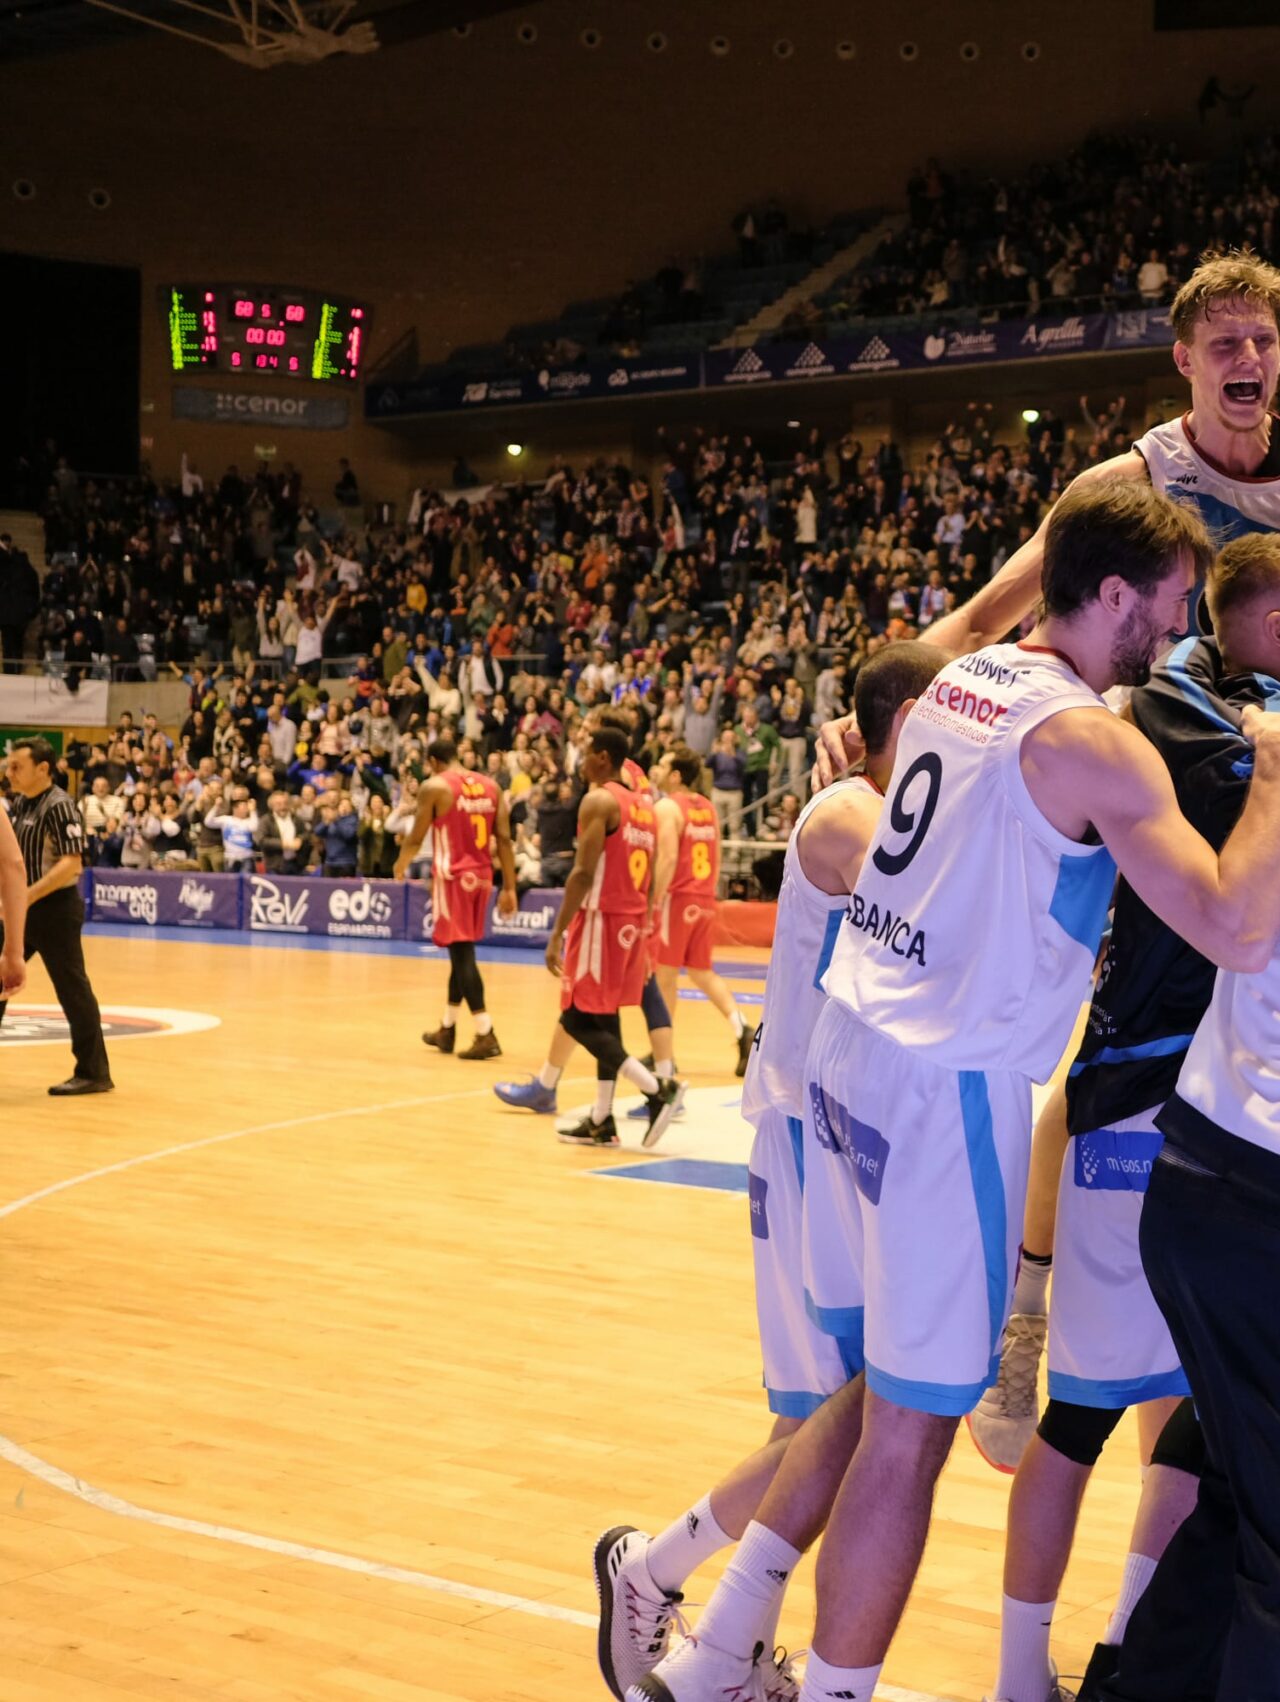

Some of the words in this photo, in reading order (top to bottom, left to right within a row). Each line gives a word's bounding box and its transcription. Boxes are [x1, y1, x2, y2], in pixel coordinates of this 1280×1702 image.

[234, 395, 309, 414] cenor
[935, 680, 1008, 727] cenor
[873, 751, 943, 877] 9
[629, 848, 648, 891] 9
[691, 841, 711, 880] 8
